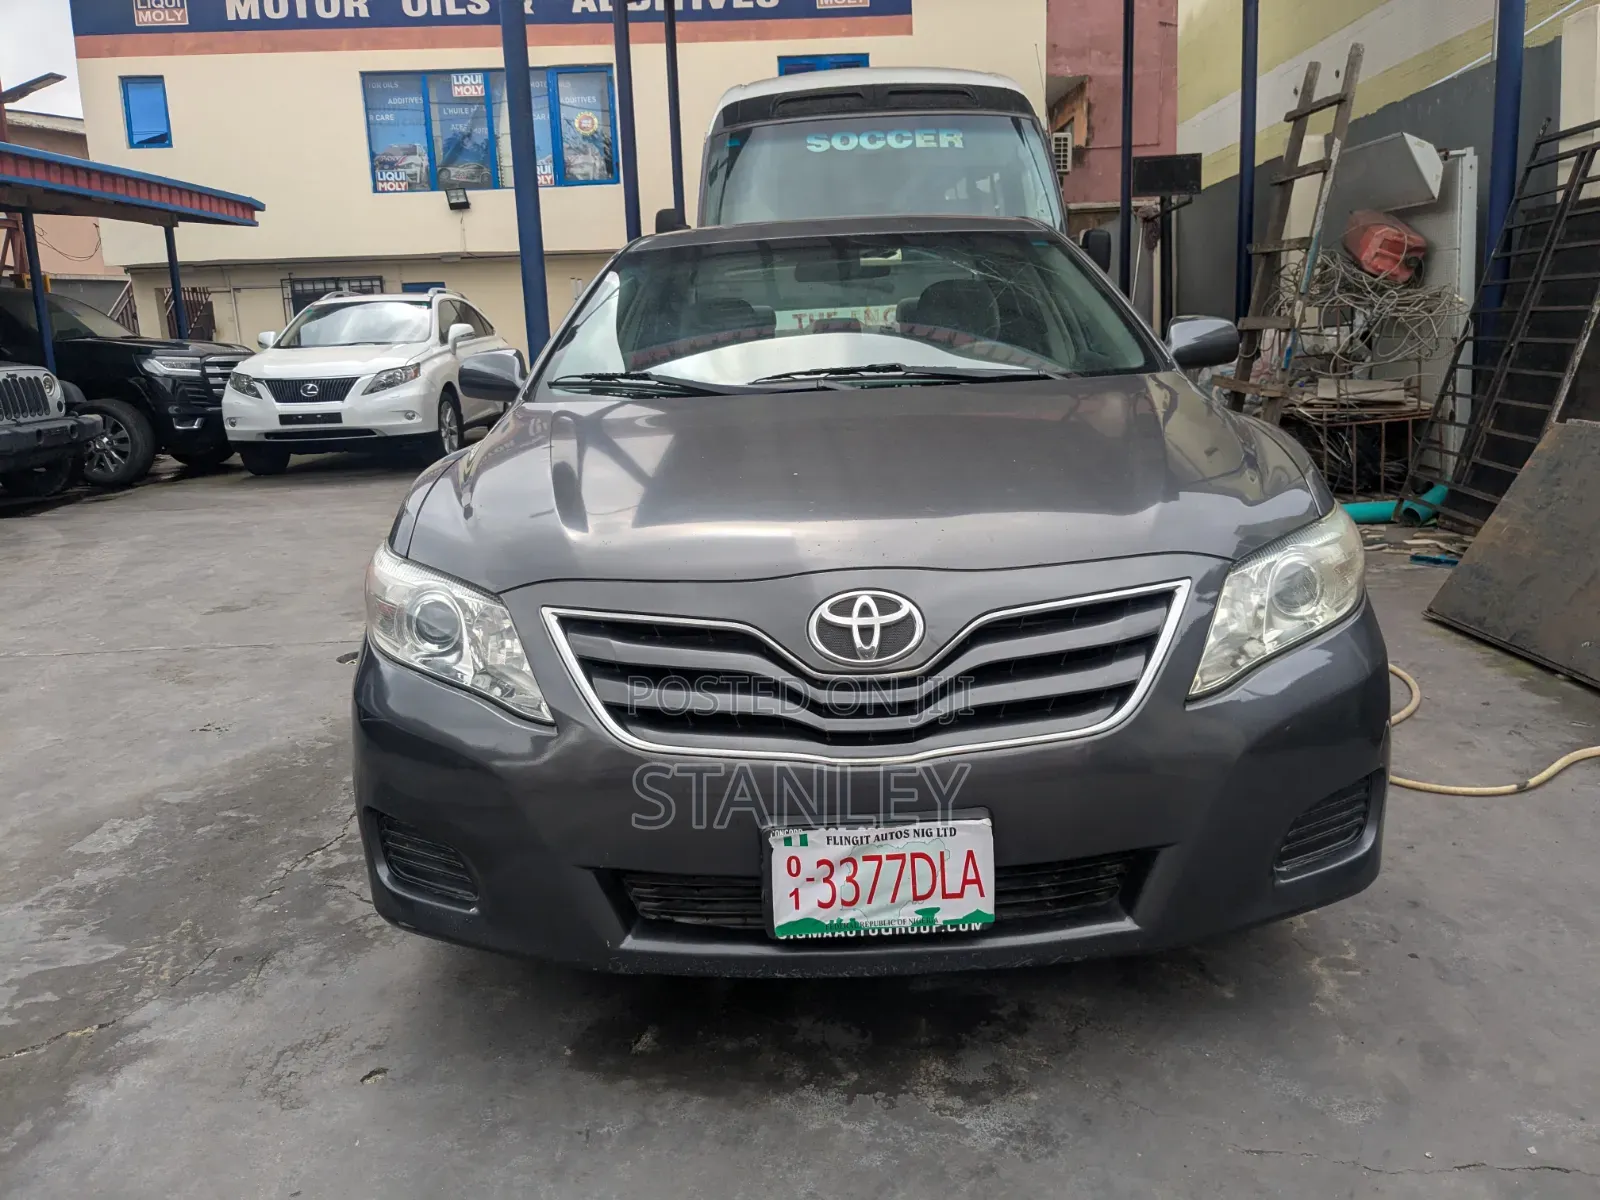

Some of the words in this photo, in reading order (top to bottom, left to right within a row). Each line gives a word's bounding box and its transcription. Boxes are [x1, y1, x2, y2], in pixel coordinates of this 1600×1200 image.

[138, 10, 184, 23] MOLY
[453, 74, 483, 86] LIQUI
[454, 85, 484, 96] MOLY
[388, 96, 424, 105] ADDITIVES
[375, 113, 395, 121] CARE
[806, 128, 965, 153] SOCCER
[377, 171, 406, 182] LIQUI
[378, 181, 408, 191] MOLY
[826, 835, 871, 846] FLINGIT
[873, 828, 910, 843] AUTOS
[913, 827, 934, 839] NIG
[936, 826, 957, 838] LTD
[860, 918, 897, 929] REPUBLIC
[897, 918, 907, 926] OF
[908, 916, 939, 925] NIGERIA
